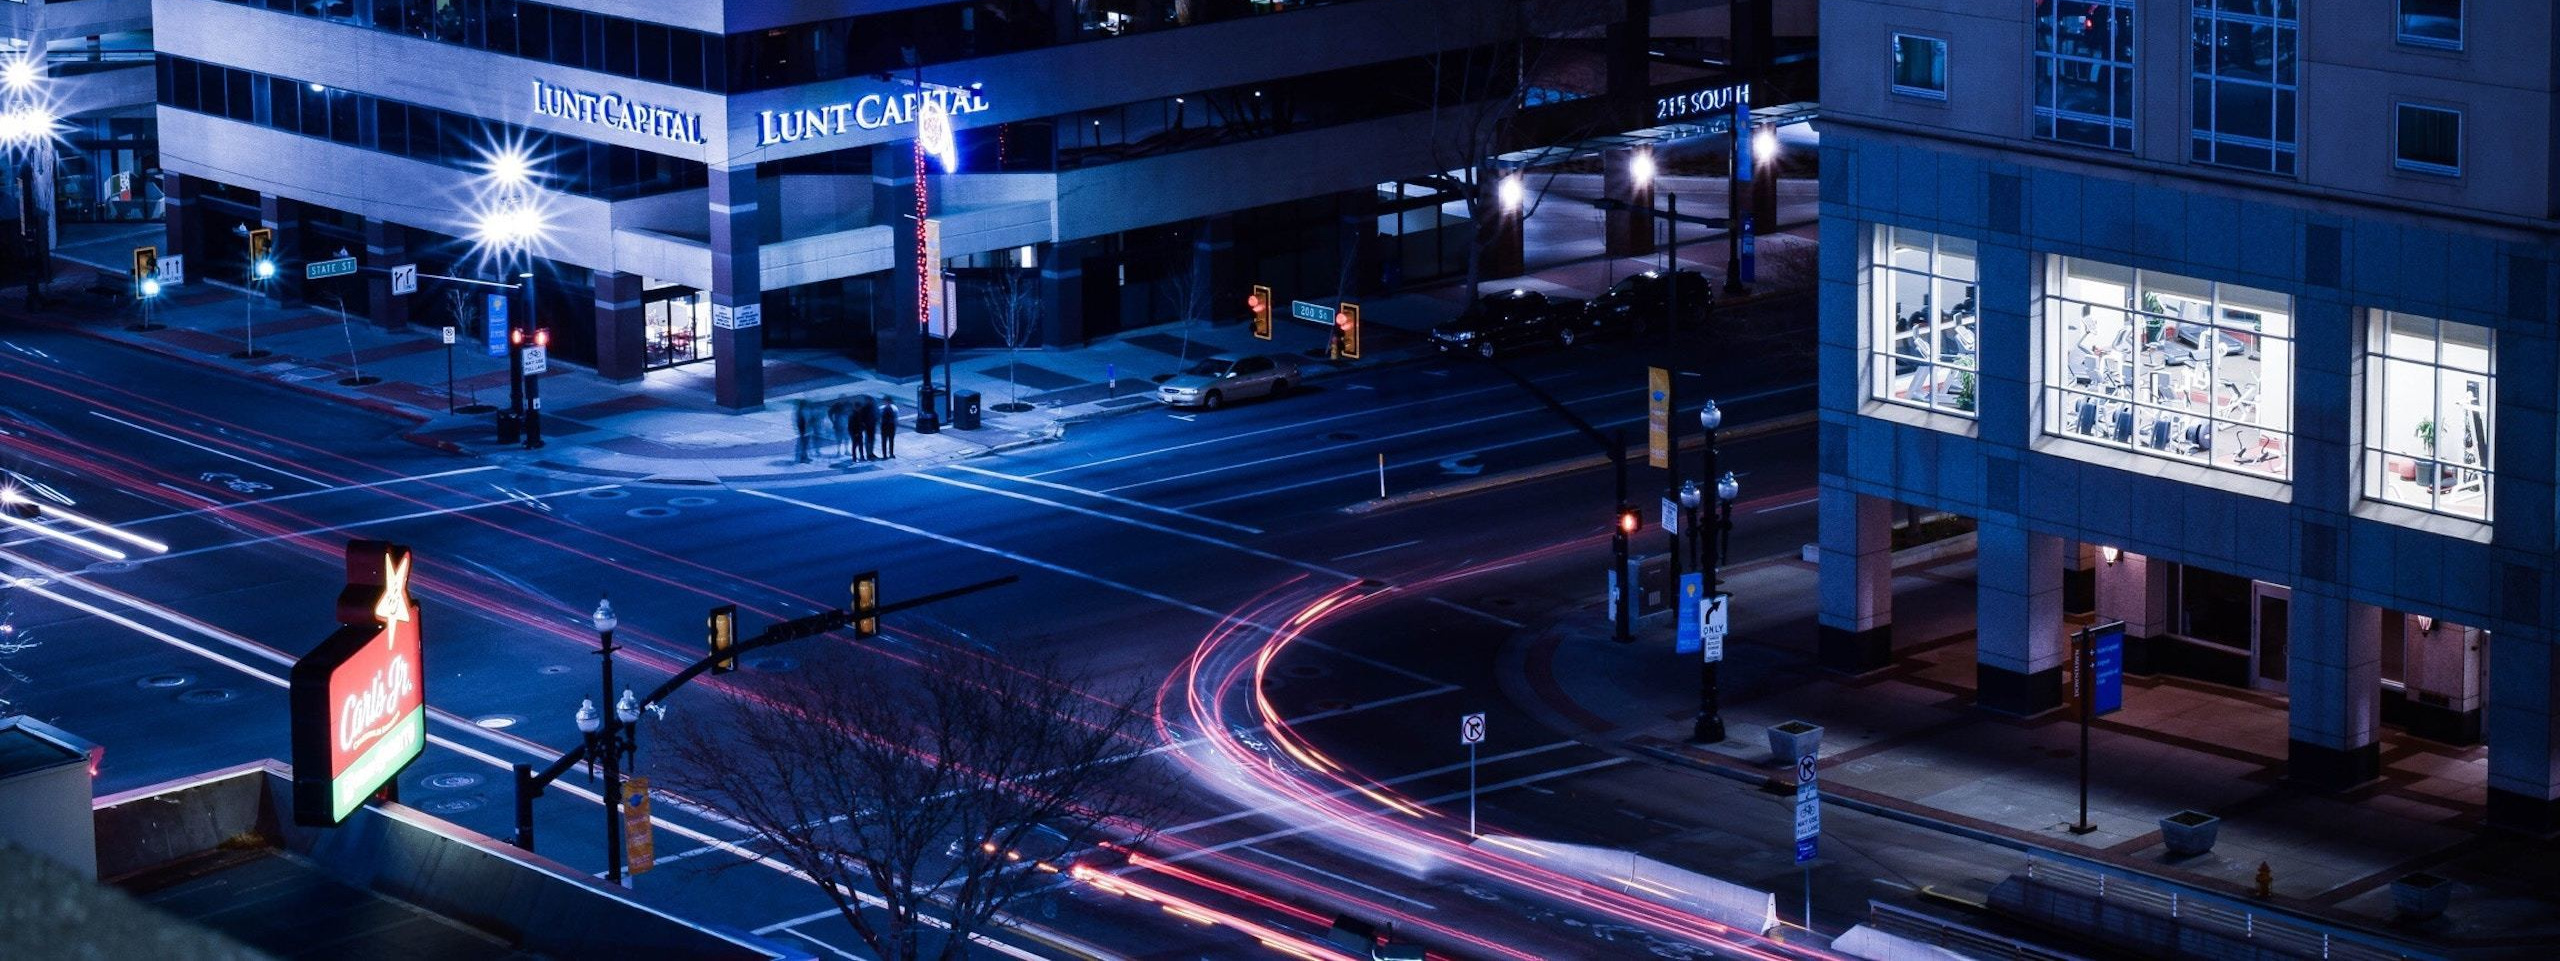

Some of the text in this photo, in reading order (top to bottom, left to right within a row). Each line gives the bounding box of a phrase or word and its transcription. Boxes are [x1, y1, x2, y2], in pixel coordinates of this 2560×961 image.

[532, 80, 707, 145] LUNT CAPITAL
[1657, 83, 1749, 119] 215 SOUTH
[760, 103, 852, 145] LUNT
[311, 261, 352, 275] STATE ST
[1300, 305, 1315, 318] 200
[1703, 624, 1724, 635] ONLY
[339, 669, 385, 752] Carl's
[387, 654, 412, 714] Jr.
